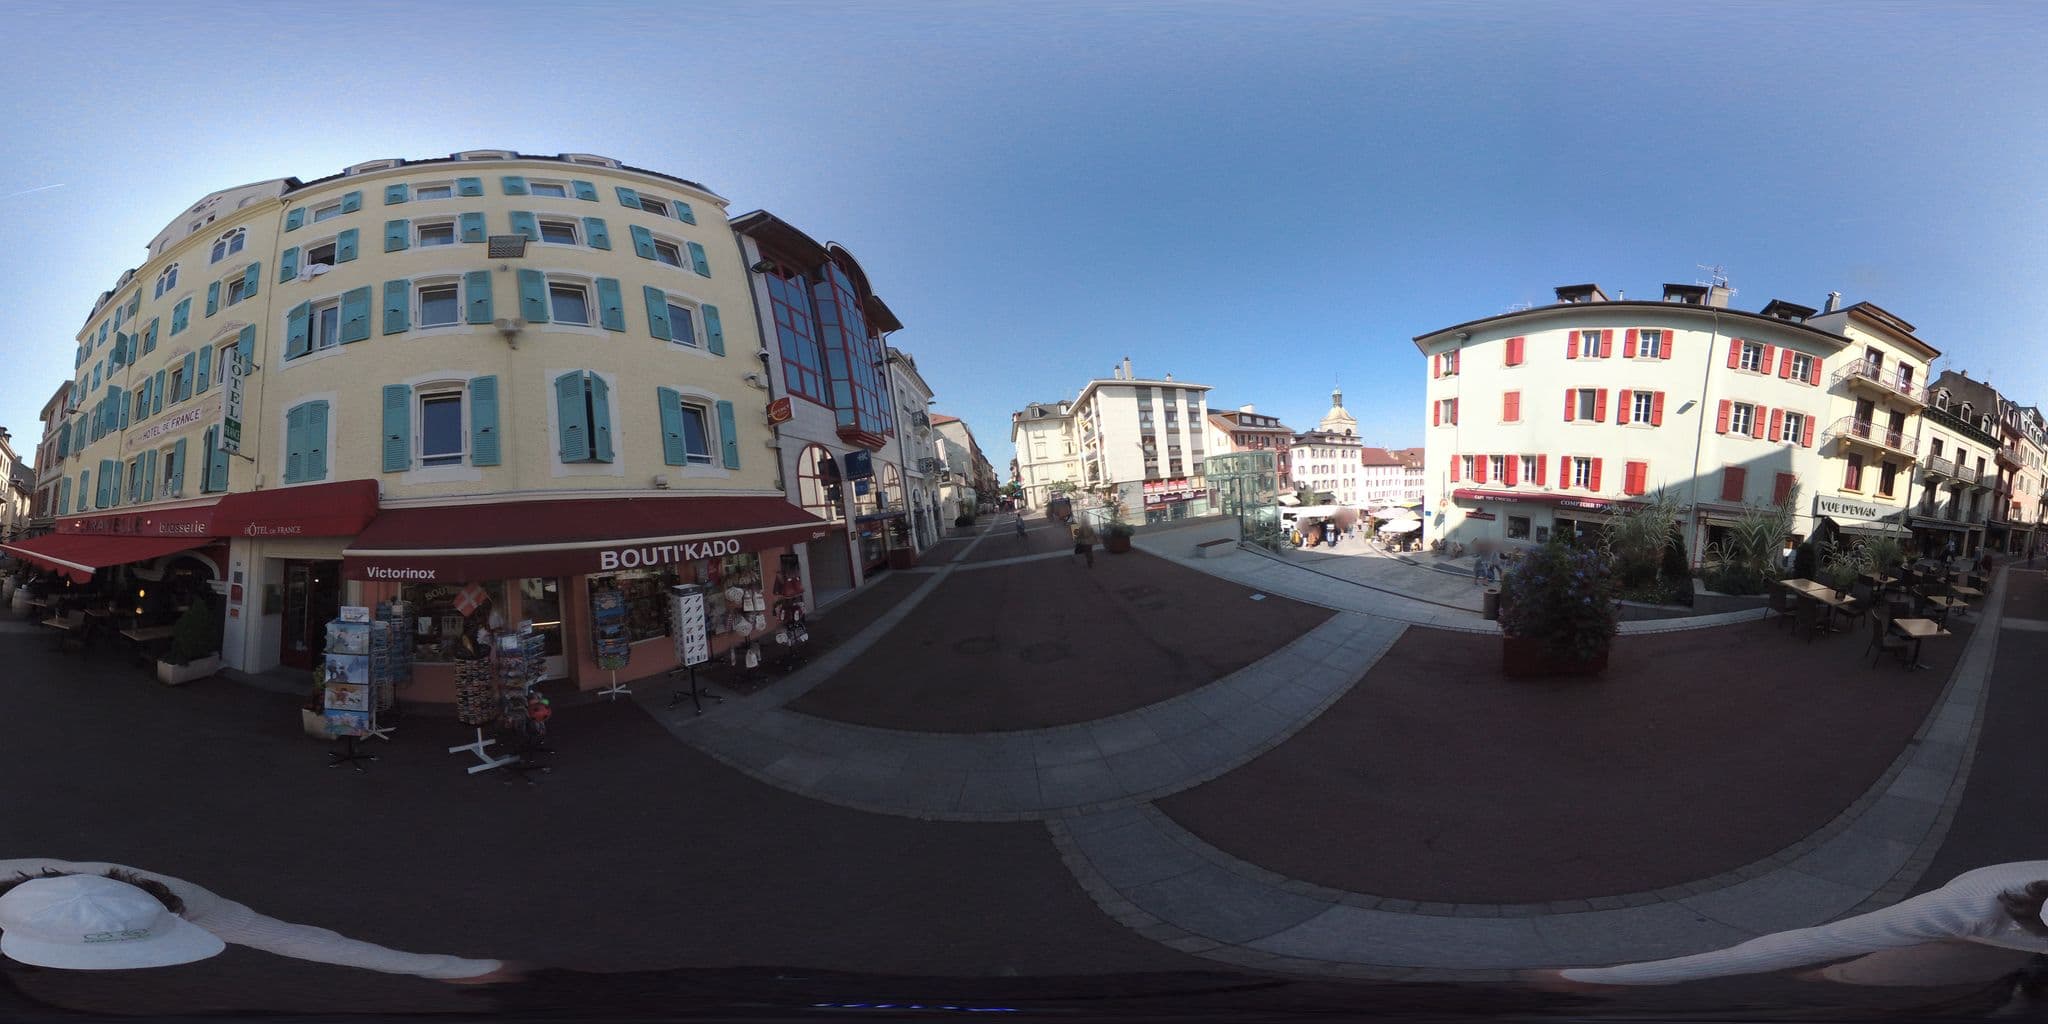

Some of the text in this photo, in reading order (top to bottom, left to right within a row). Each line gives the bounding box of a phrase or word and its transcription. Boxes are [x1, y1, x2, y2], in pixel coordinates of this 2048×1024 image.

[230, 348, 242, 419] HOTEL
[171, 408, 201, 428] FRANCE
[1821, 501, 1877, 517] VUE D'EVIAN
[159, 520, 206, 534] brasserie
[600, 539, 740, 570] BOUTI'KADO
[367, 566, 436, 580] Victorinox
